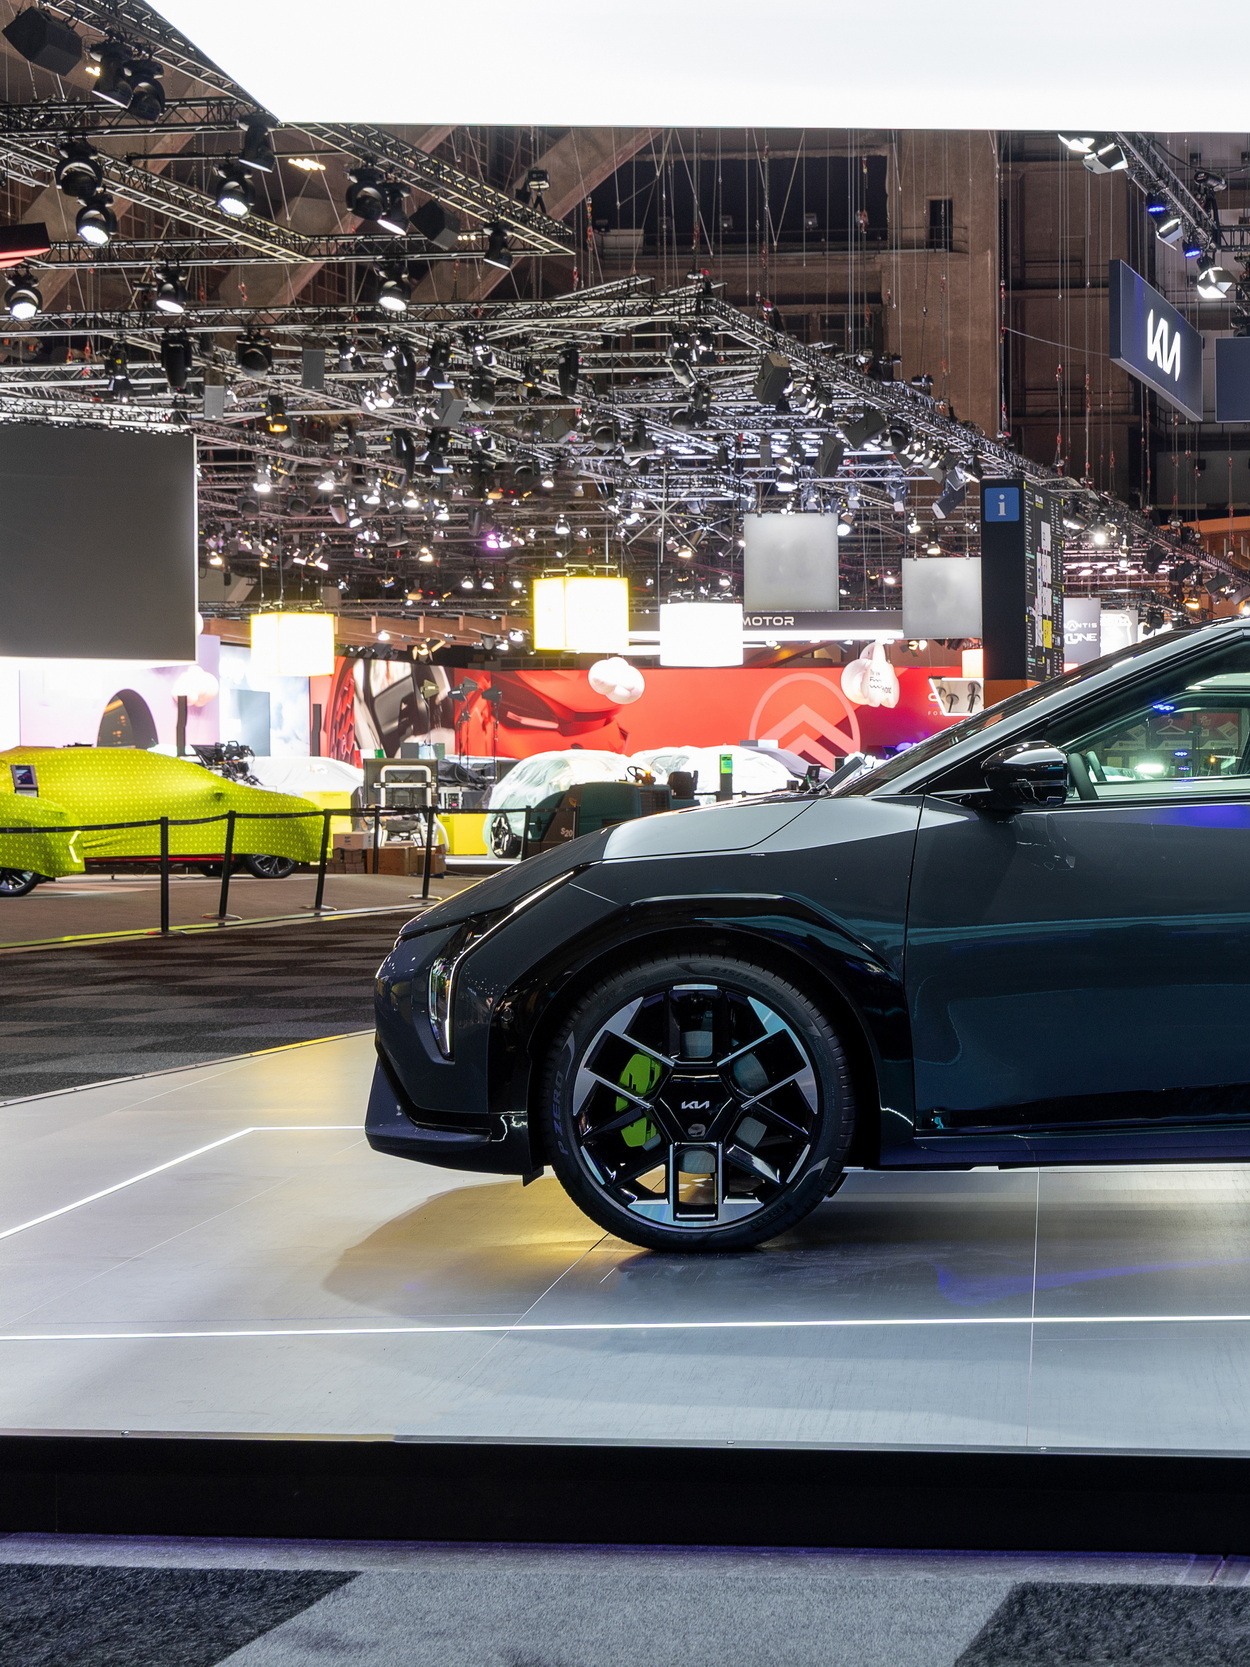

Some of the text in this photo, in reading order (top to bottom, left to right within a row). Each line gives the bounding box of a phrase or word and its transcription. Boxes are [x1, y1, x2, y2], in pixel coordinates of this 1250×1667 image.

[1146, 309, 1181, 382] KIA
[560, 827, 573, 838] S20
[553, 1070, 570, 1156] P ZERO
[681, 1101, 710, 1109] KIA
